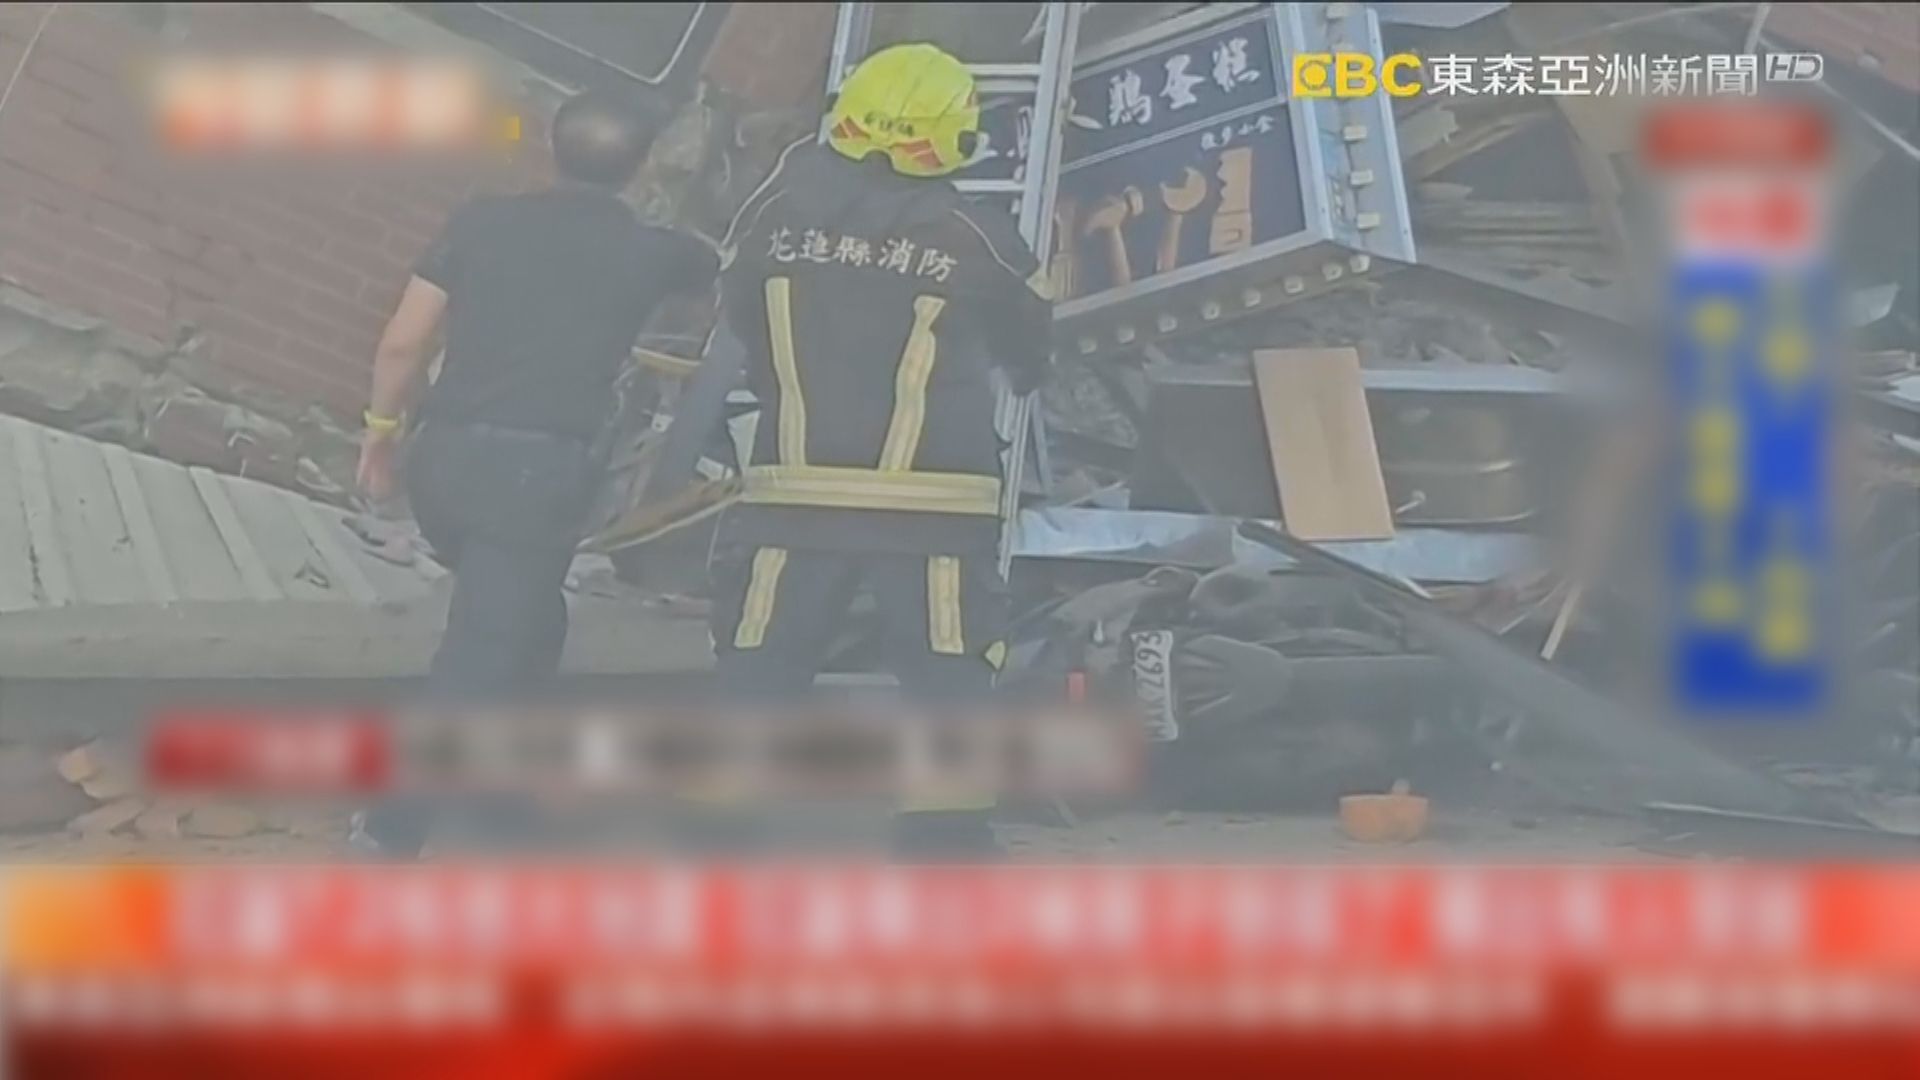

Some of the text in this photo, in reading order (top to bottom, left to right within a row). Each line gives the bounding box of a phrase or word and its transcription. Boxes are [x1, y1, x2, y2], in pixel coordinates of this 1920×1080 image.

[766, 226, 958, 283] 花蓮縣消防
